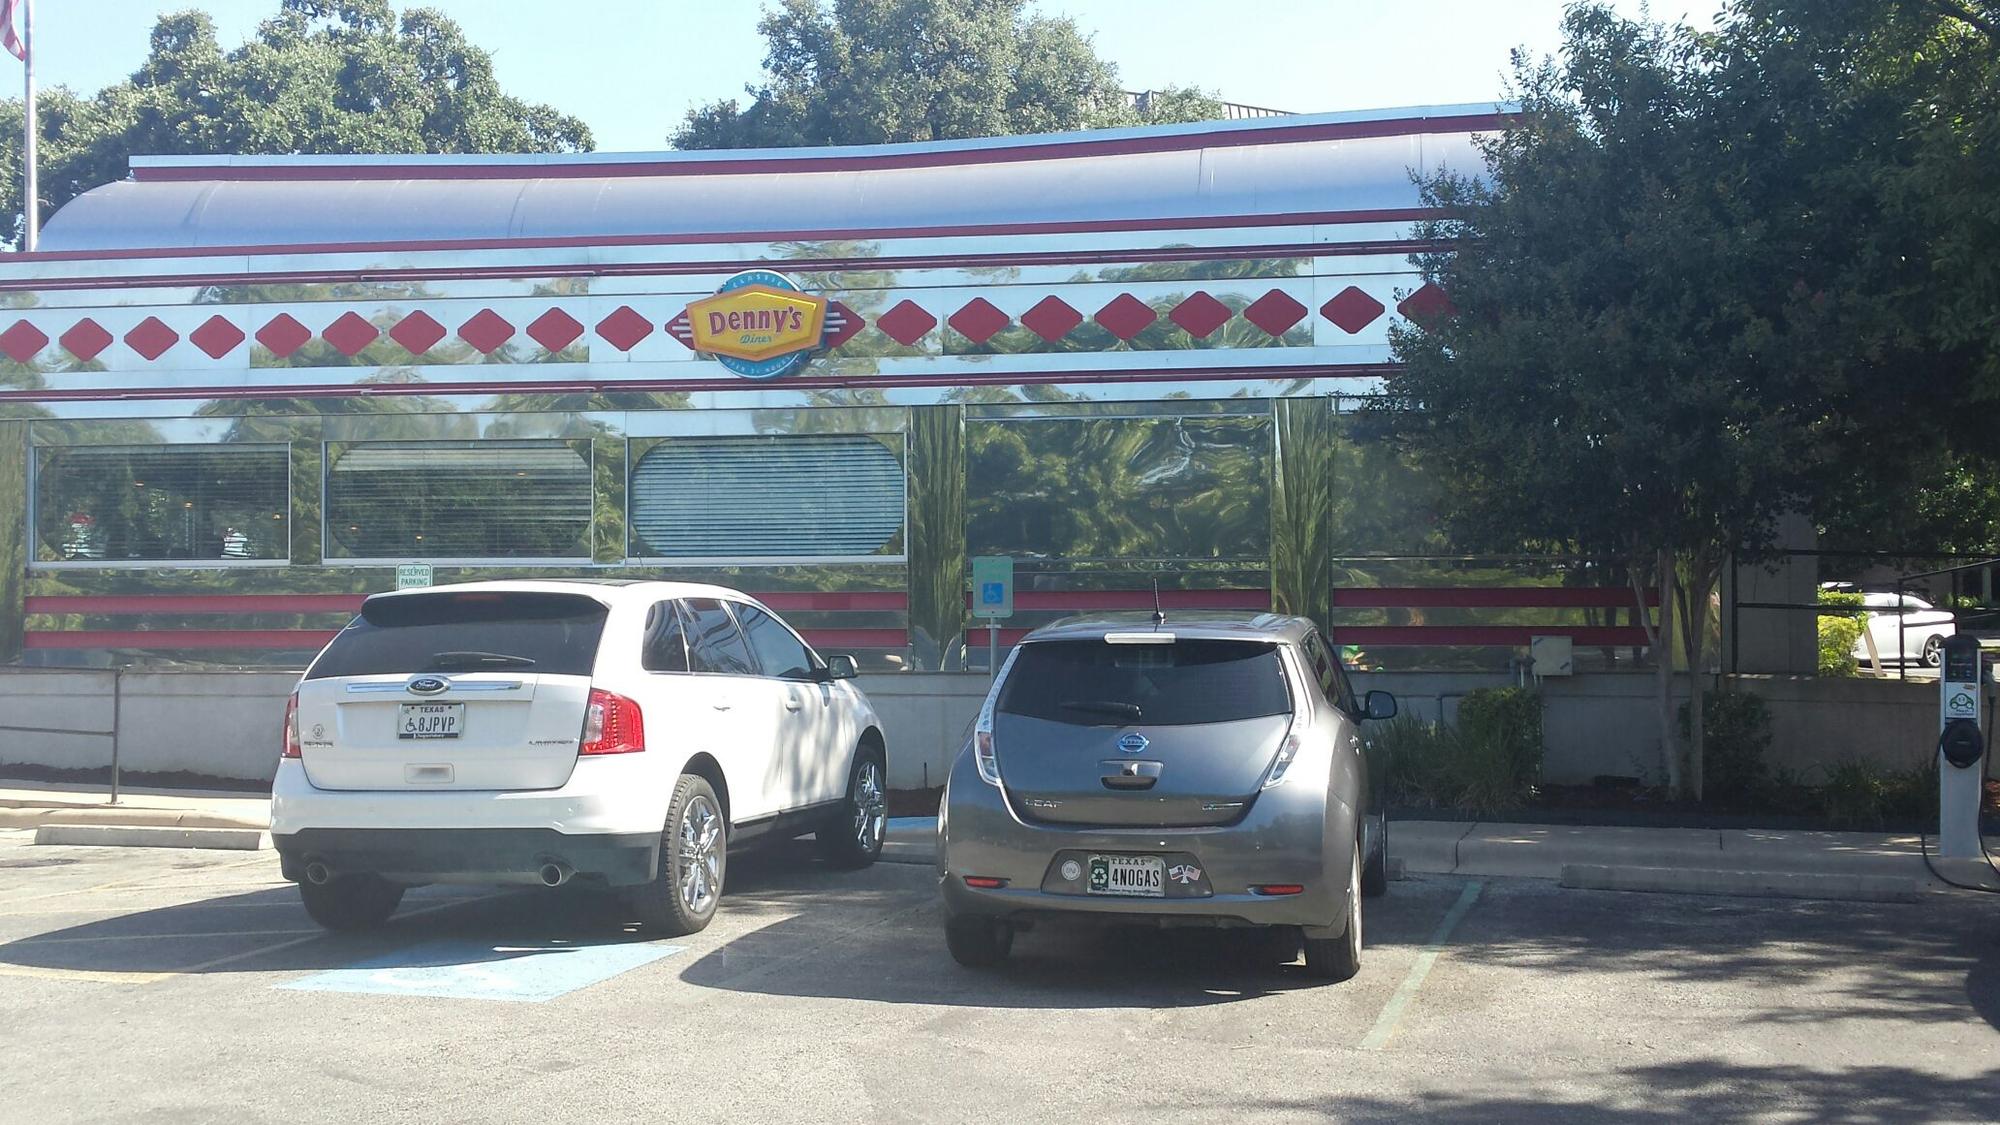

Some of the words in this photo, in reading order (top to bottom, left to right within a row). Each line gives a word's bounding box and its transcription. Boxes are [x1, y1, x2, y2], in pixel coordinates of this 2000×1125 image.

[709, 306, 802, 335] Denny's
[739, 334, 773, 344] Diner
[400, 568, 429, 576] RESERVED
[418, 716, 455, 732] 8JPVP
[1025, 798, 1063, 808] LEAF
[1111, 857, 1146, 866] TEXAS
[1111, 867, 1160, 887] 4NOGAS
